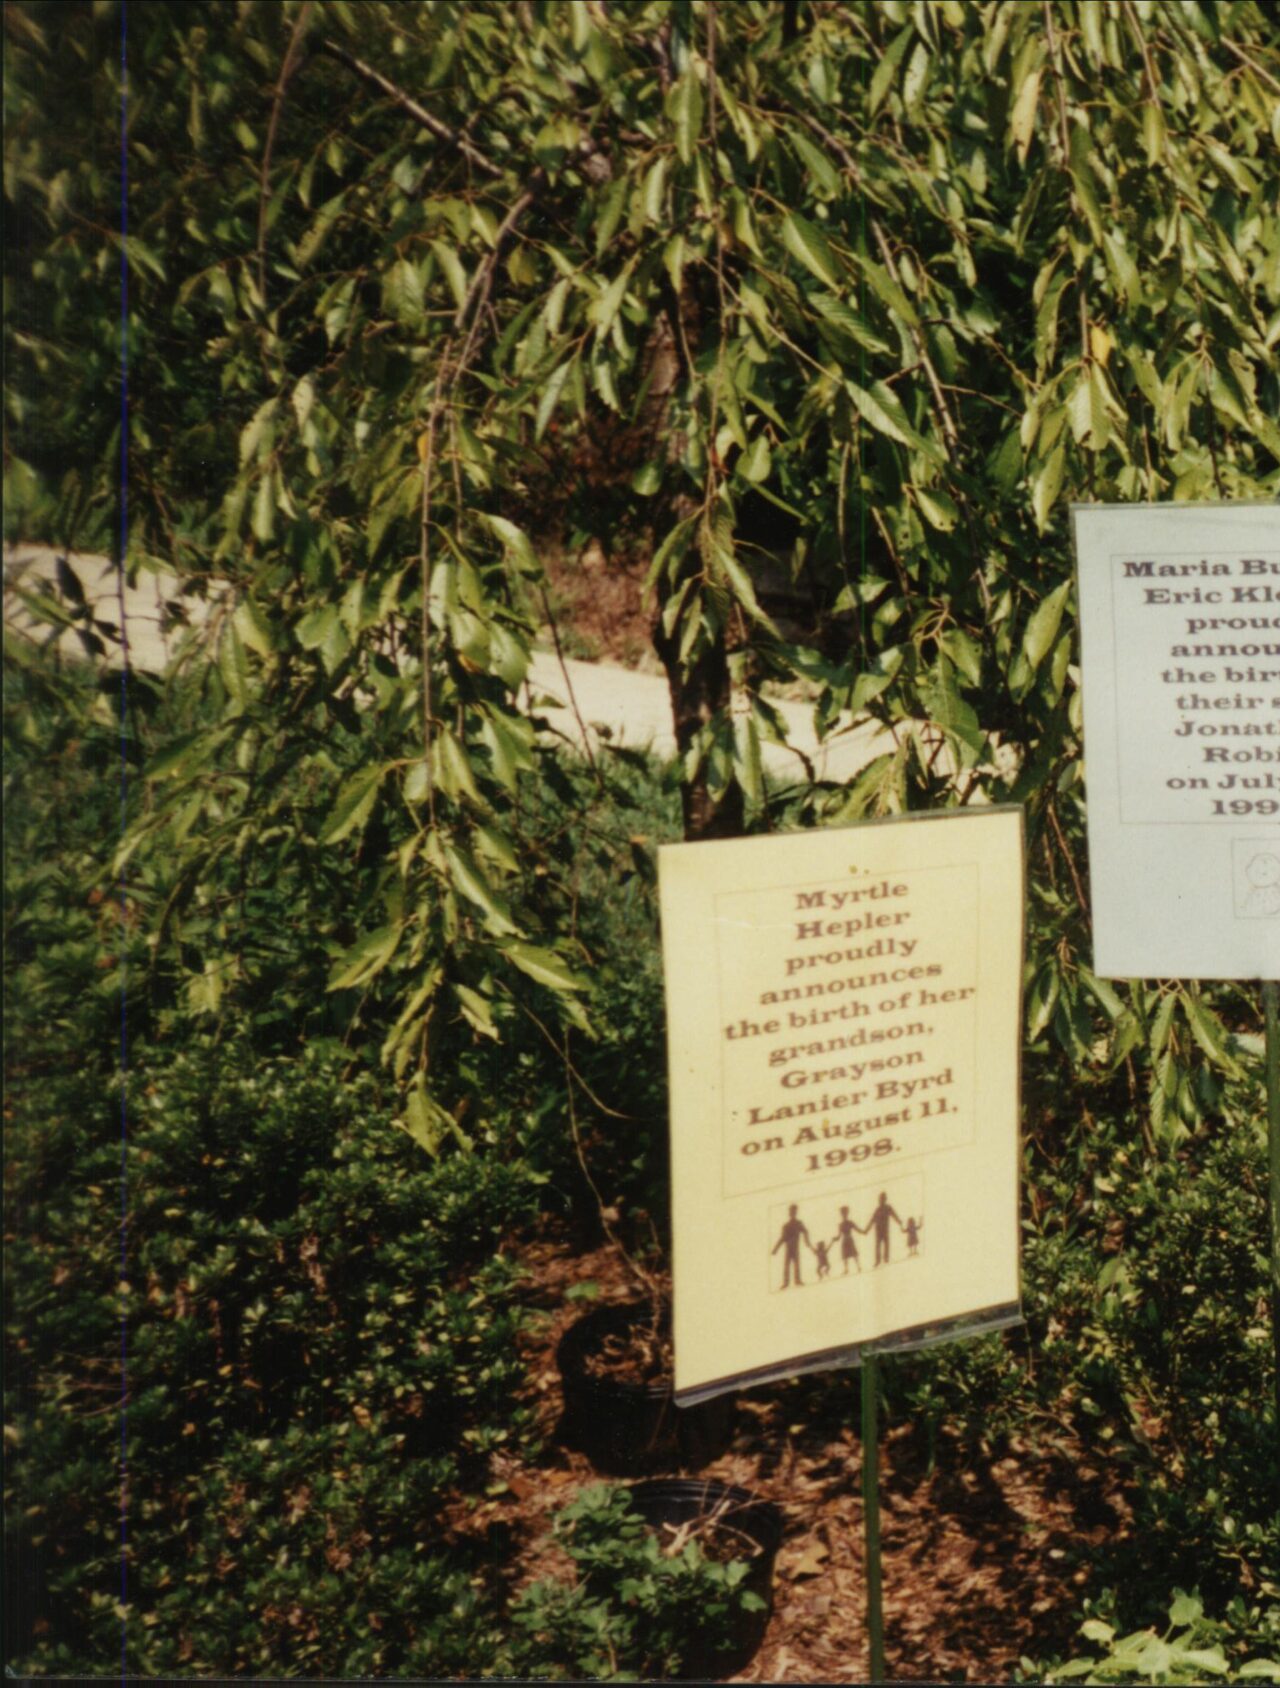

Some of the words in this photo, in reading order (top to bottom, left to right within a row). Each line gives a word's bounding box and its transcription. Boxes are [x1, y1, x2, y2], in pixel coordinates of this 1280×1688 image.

[1122, 559, 1232, 578] Maria
[1143, 586, 1222, 605] Eric
[1161, 667, 1217, 684] the
[1175, 692, 1265, 711] their
[1165, 777, 1210, 790] on
[795, 880, 909, 911] Myrtle
[795, 911, 911, 941] Hepler
[785, 937, 919, 977] proudly
[759, 961, 943, 1006] announces
[723, 1019, 781, 1041] the
[787, 1000, 871, 1029] birth
[877, 991, 913, 1013] of
[919, 986, 977, 1006] her
[767, 1021, 935, 1068] grandson,
[779, 1049, 925, 1090] Grayson
[748, 1091, 869, 1126] Lanier
[875, 1067, 954, 1102] Byrd
[740, 1136, 785, 1156] on
[792, 1108, 913, 1146] August
[920, 1097, 958, 1118] 11,
[807, 1137, 901, 1172] 1998.
